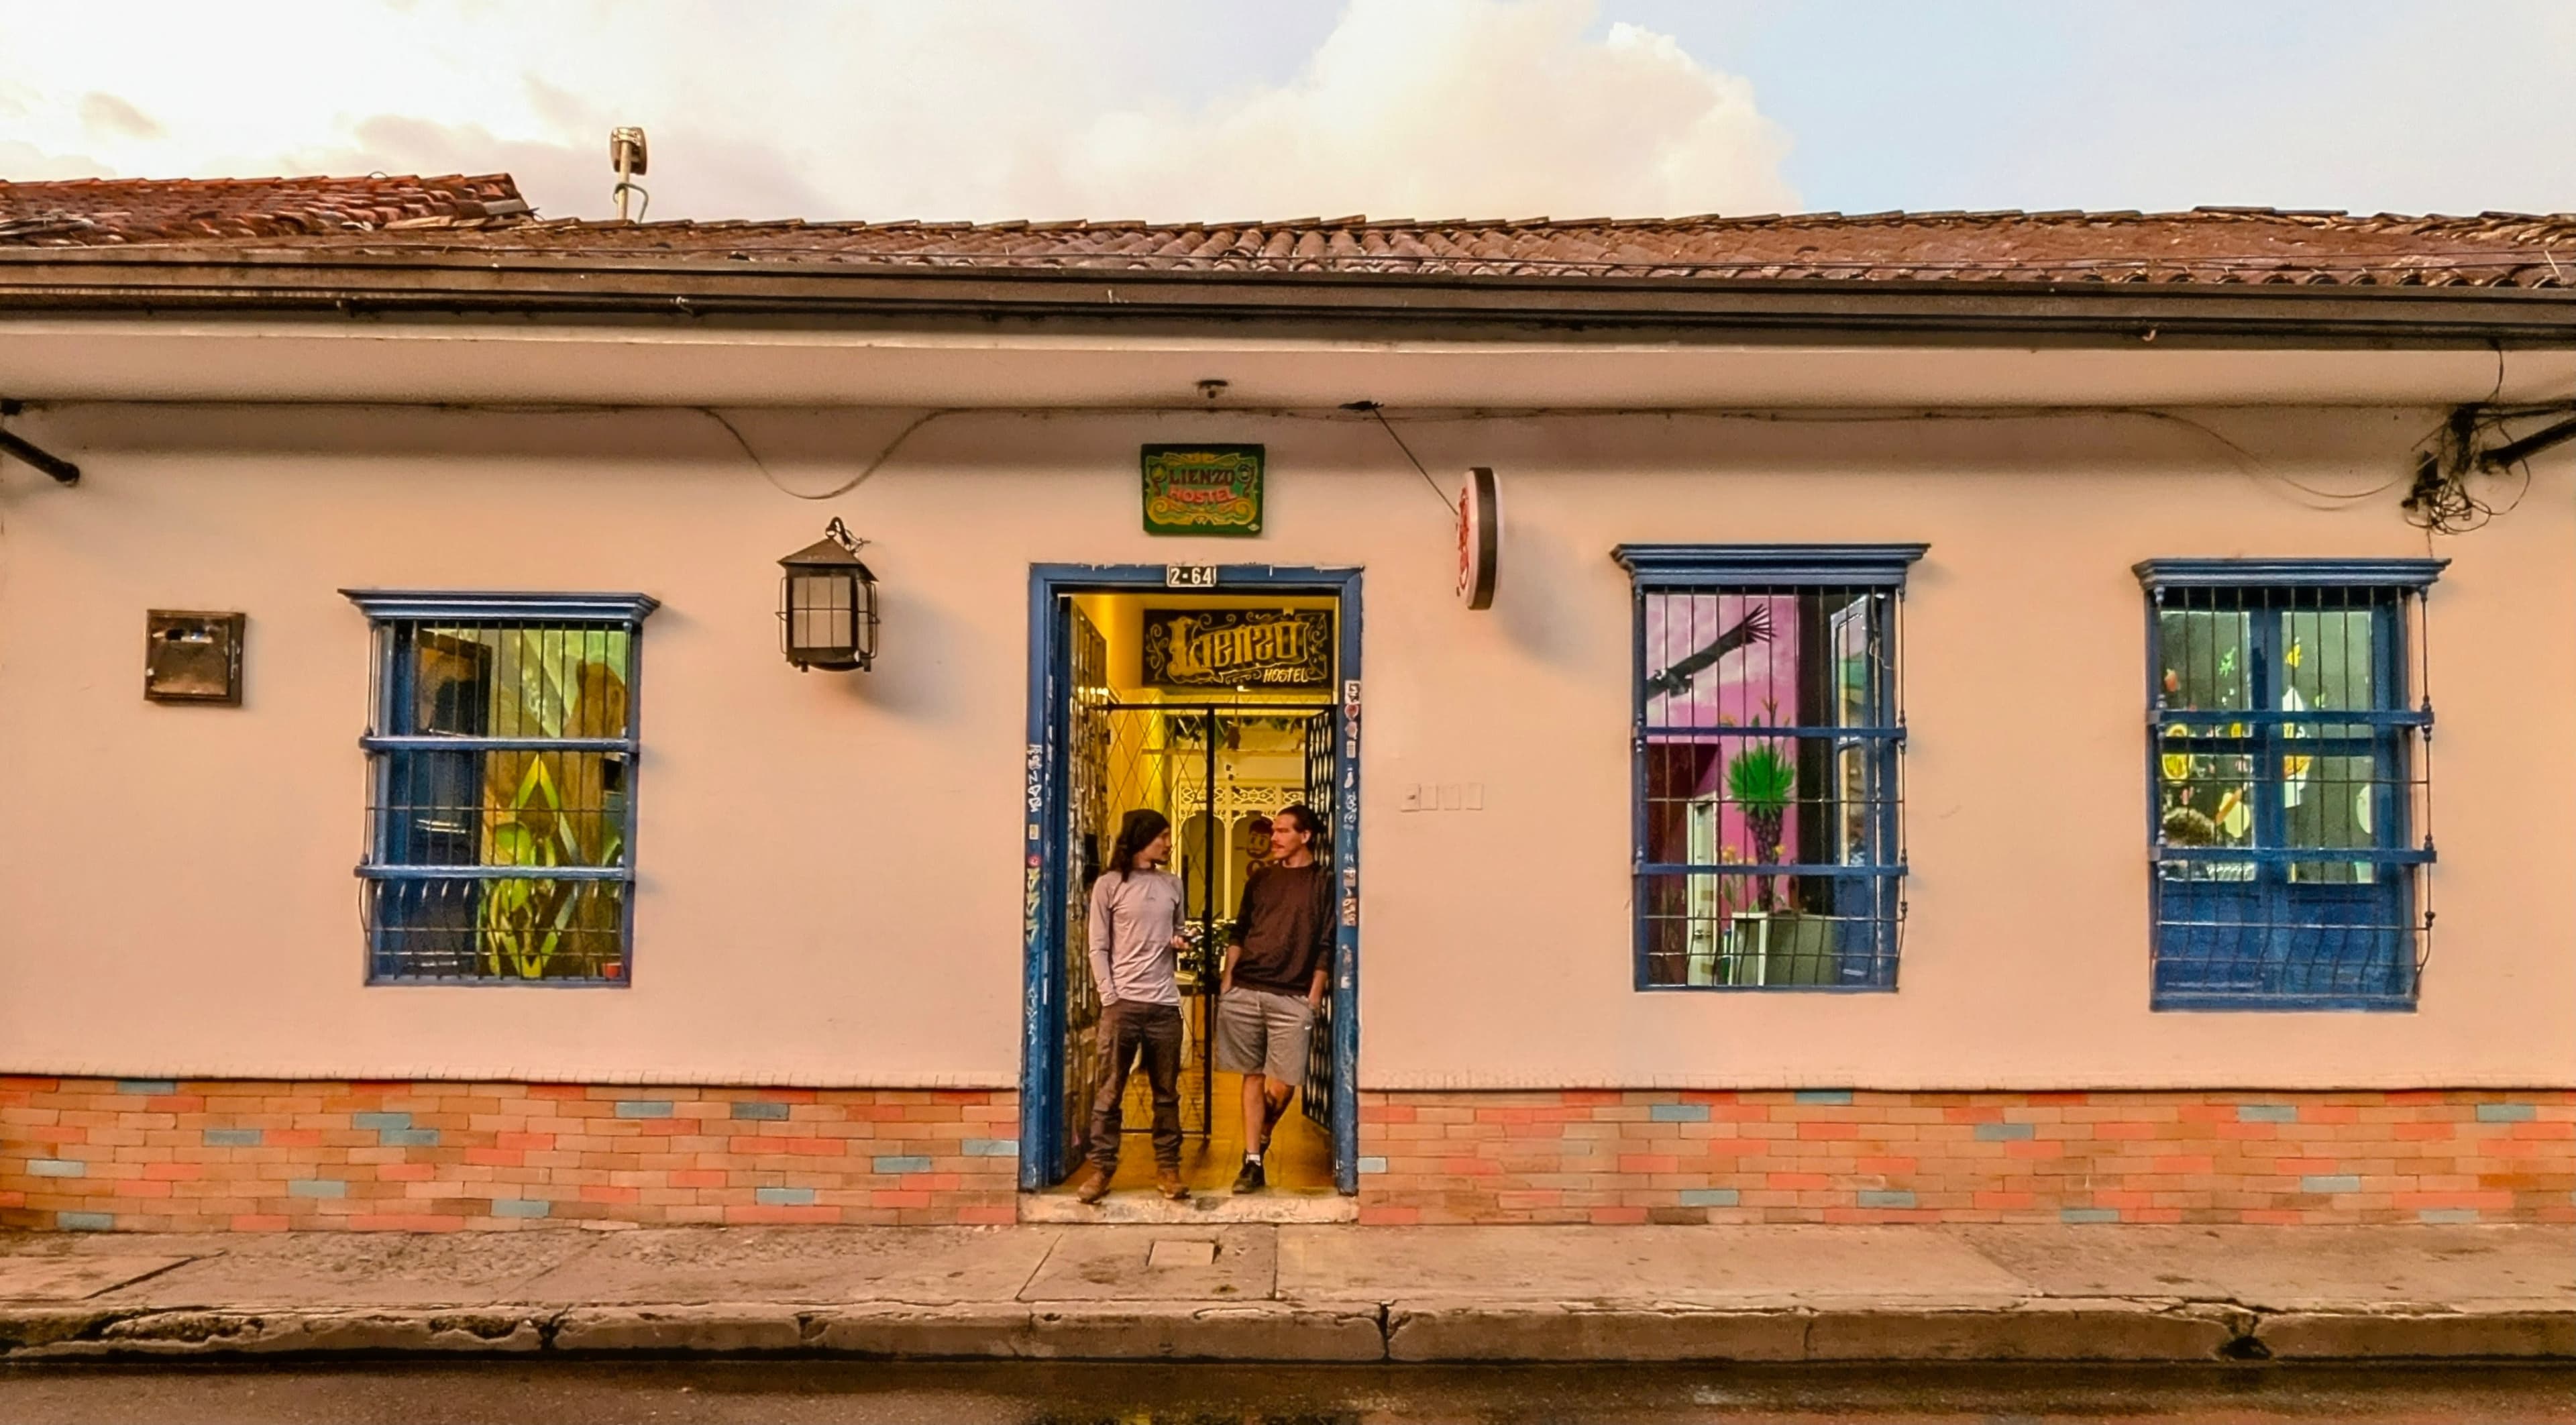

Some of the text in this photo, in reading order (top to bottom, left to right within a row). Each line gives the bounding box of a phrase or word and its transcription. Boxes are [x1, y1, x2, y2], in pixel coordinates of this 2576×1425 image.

[1168, 468, 1235, 485] LIENZO
[1168, 484, 1237, 504] HOSTEL
[1262, 667, 1309, 683] HOSTEL
